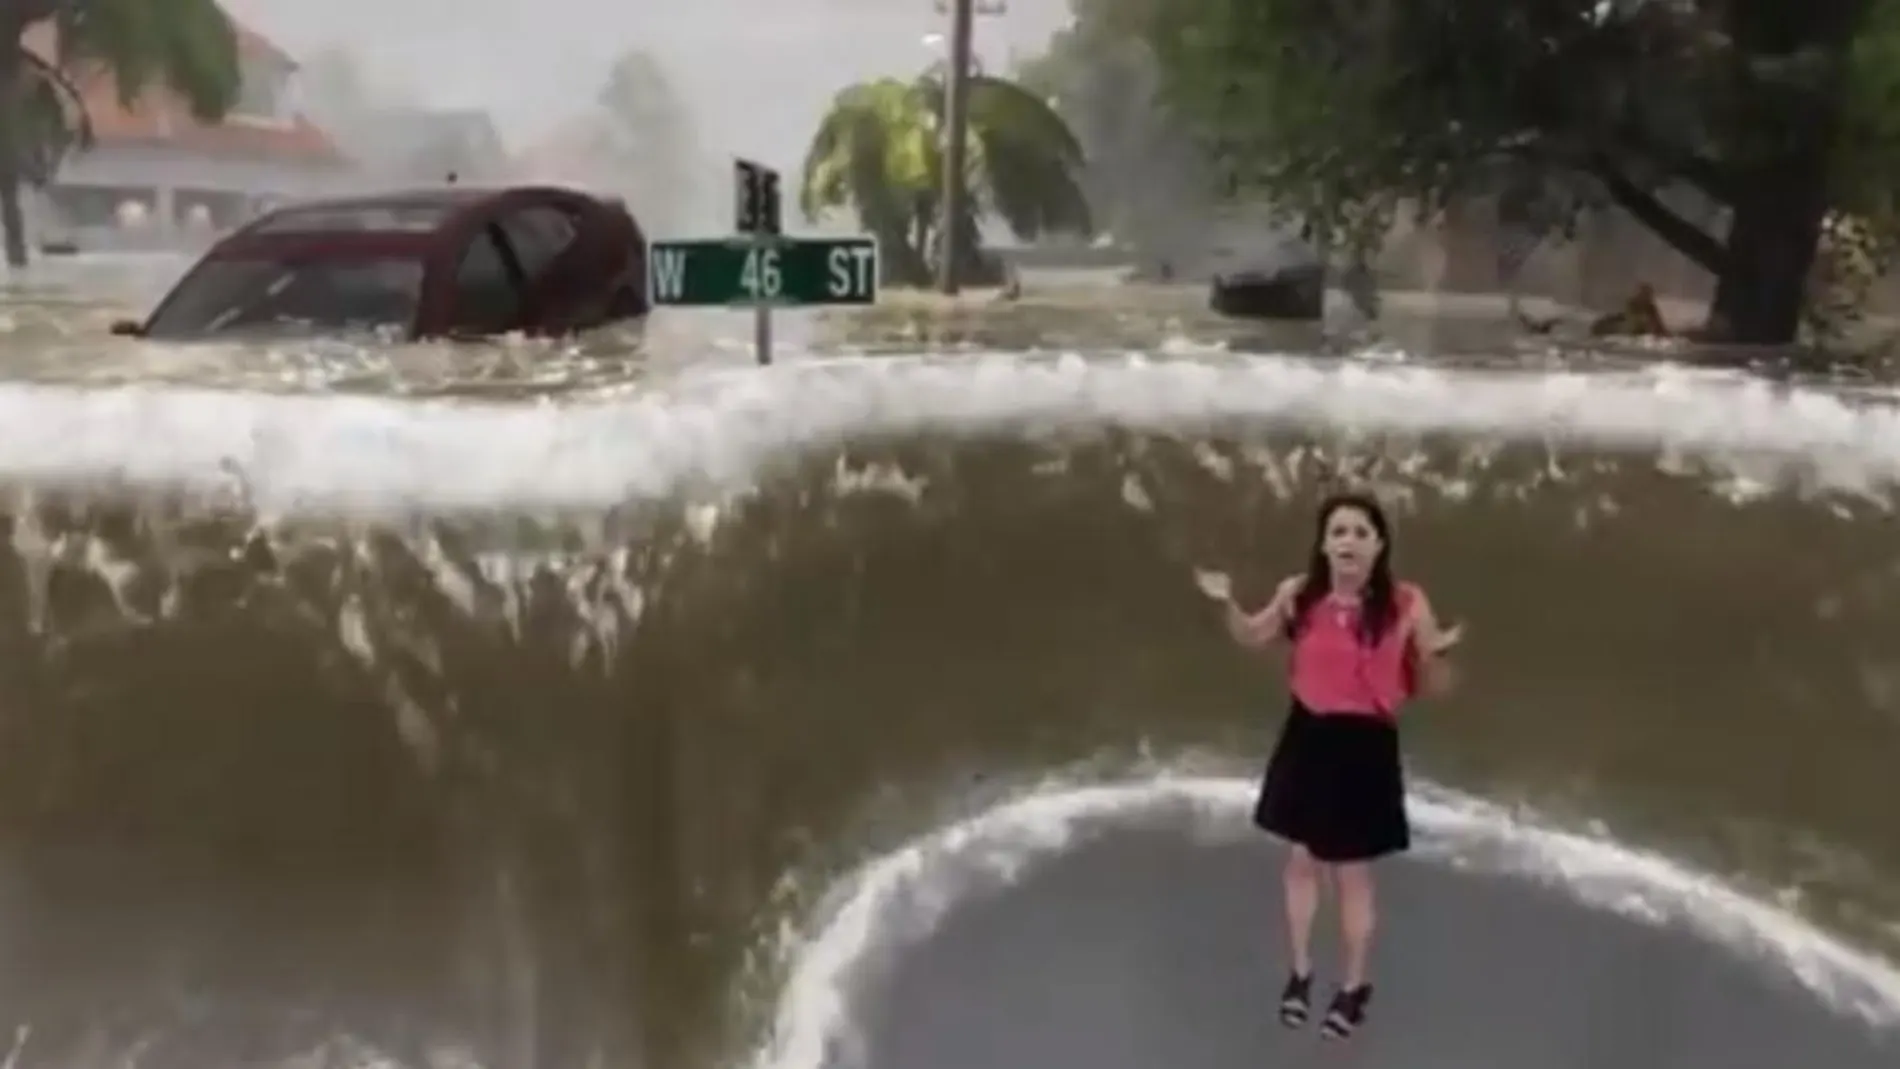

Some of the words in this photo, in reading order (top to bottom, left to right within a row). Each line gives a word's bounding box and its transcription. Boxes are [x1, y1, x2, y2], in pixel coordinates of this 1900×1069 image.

[652, 250, 686, 298] W
[740, 248, 781, 297] 46
[829, 246, 872, 297] ST
